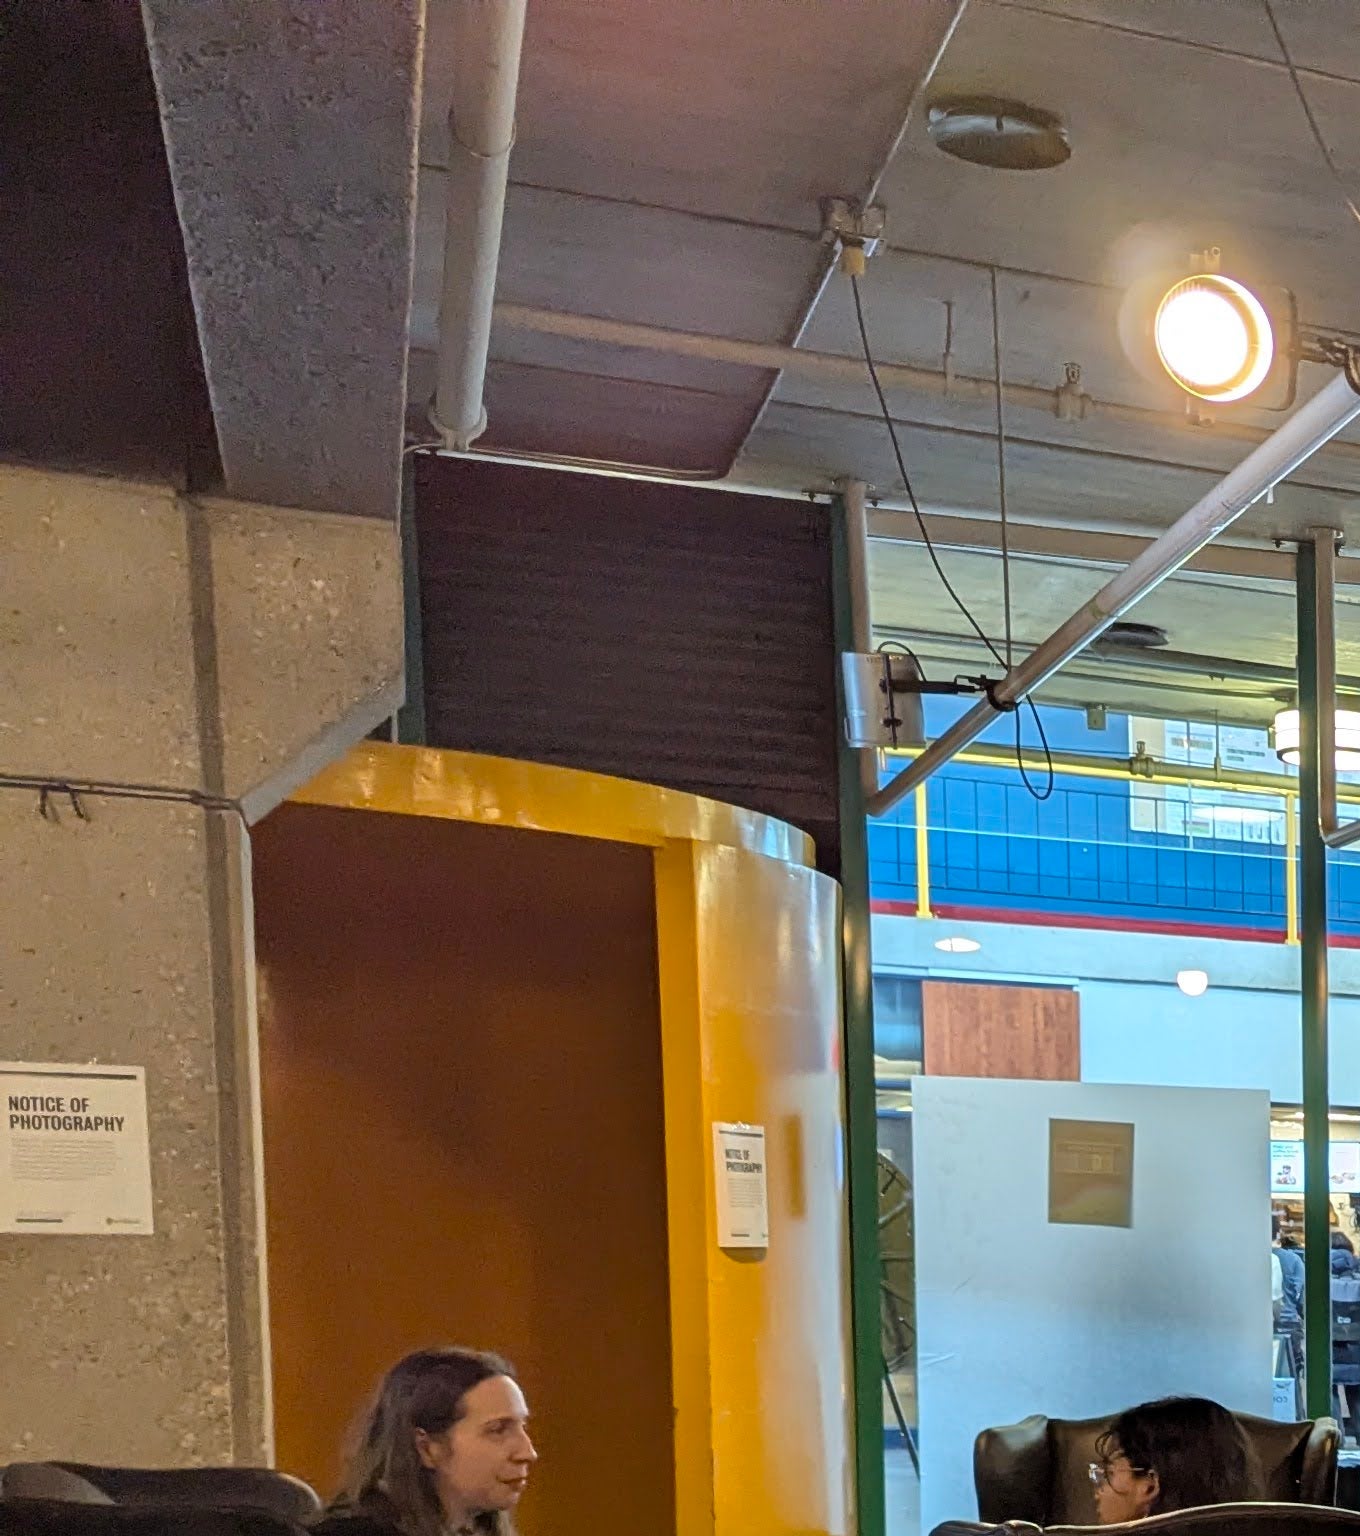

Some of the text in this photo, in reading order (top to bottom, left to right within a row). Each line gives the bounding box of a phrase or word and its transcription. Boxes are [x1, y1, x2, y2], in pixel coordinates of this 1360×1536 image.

[8, 1095, 90, 1113] NOTICE OF
[9, 1114, 125, 1132] PHOTOGRAPHY
